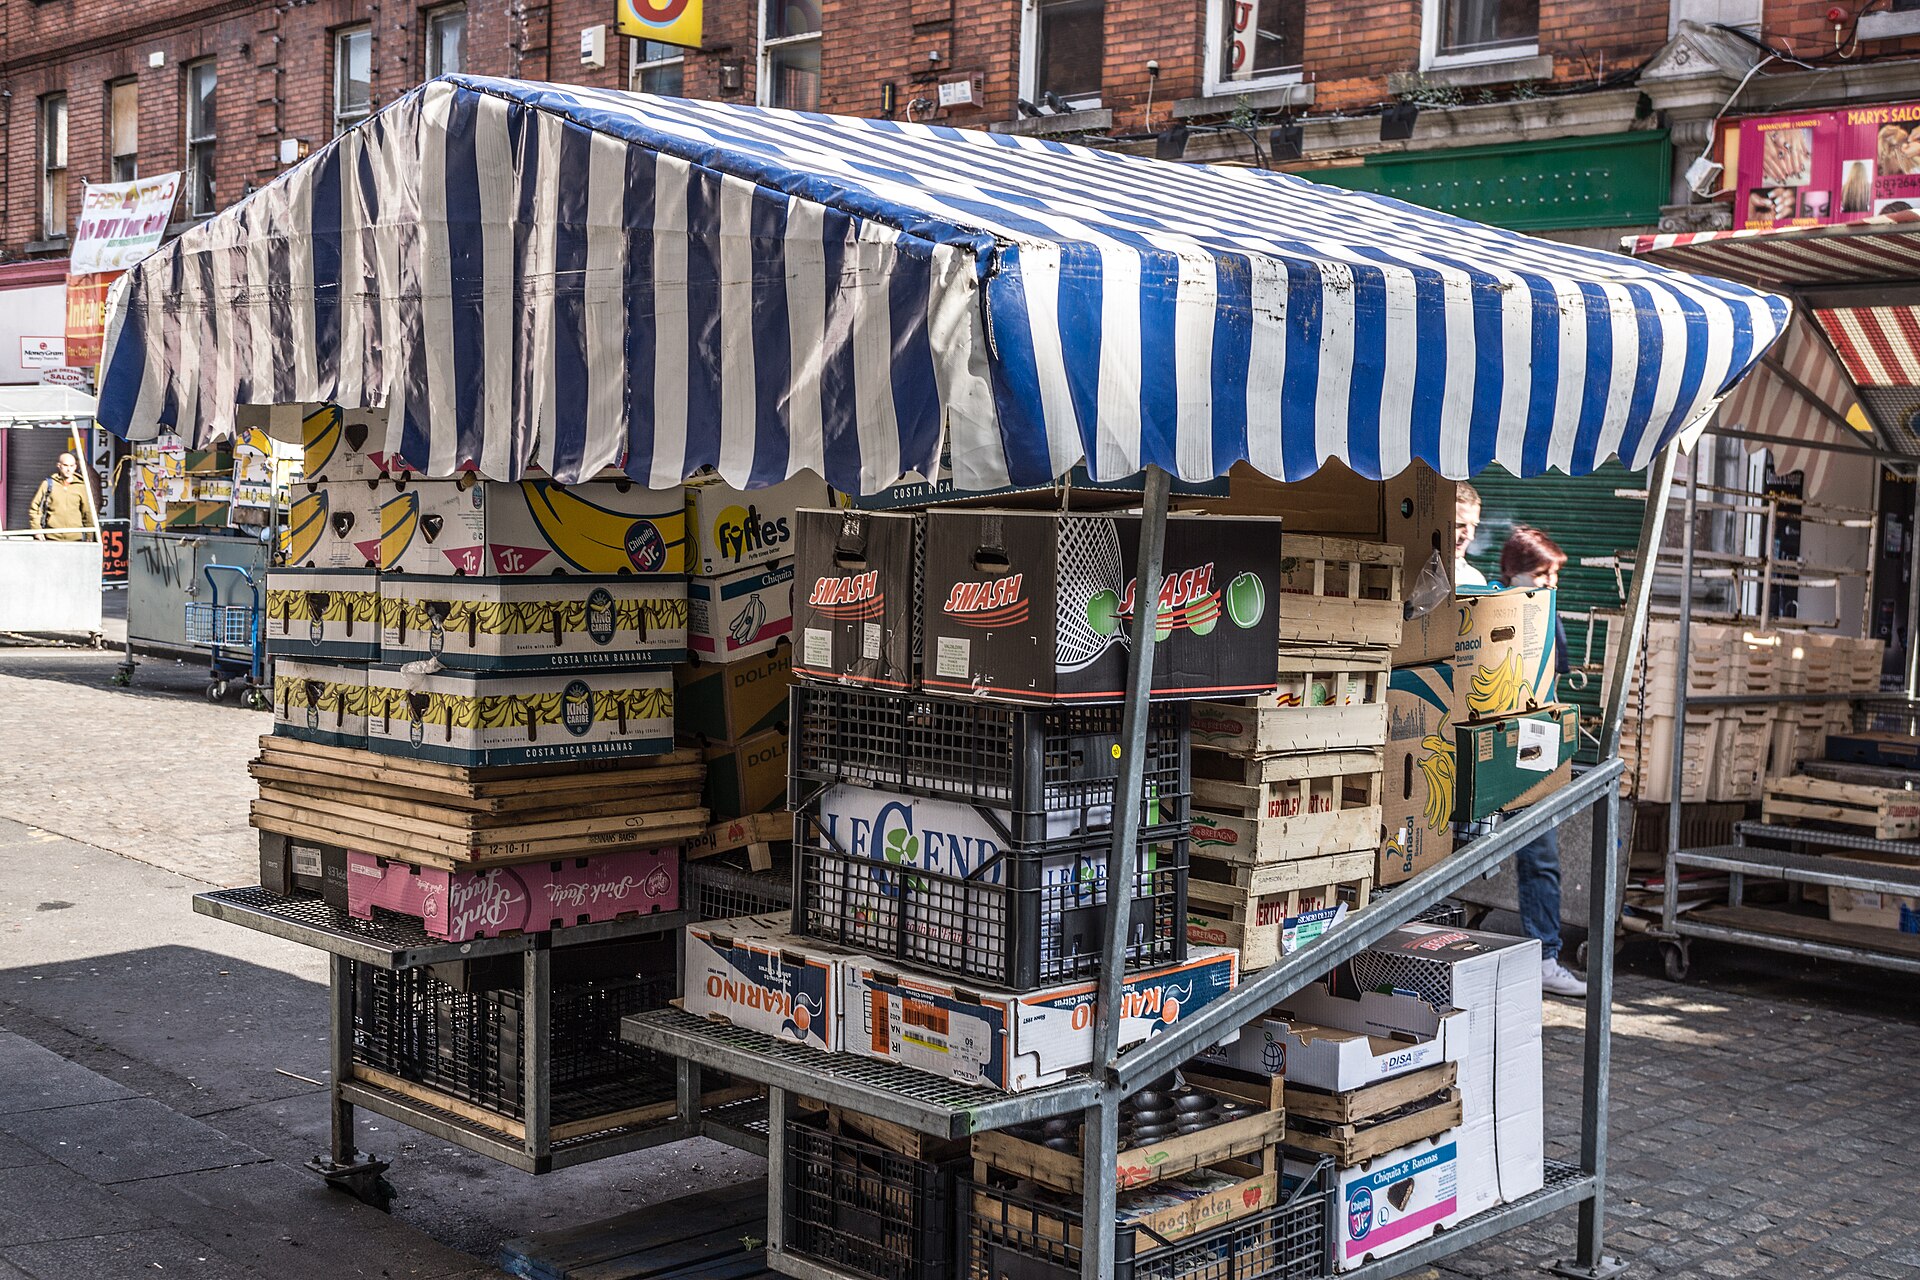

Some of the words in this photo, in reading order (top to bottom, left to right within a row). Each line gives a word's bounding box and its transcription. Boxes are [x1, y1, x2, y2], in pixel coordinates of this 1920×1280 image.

[1848, 109, 1888, 125] MARY'S
[1891, 107, 1920, 121] SALO
[88, 192, 122, 209] CASH
[122, 183, 141, 214] 4
[140, 182, 175, 205] GOLD
[95, 218, 121, 239] BUY
[50, 373, 80, 381] SALON
[893, 485, 925, 499] COSTA
[627, 528, 655, 552] Chiquita
[462, 550, 477, 571] Jr.
[499, 548, 525, 573] Jr.
[638, 545, 660, 566] Jr.
[102, 559, 111, 569] ry
[761, 571, 793, 586] Chiquita
[808, 570, 879, 605] SMASH
[943, 573, 1024, 613] SMASH
[591, 609, 611, 625] KING
[591, 623, 612, 633] CARIBE
[1455, 636, 1482, 652] anacol
[551, 655, 580, 665] COSTA
[584, 653, 610, 664] RICAN
[614, 651, 652, 662] BANANAS
[734, 656, 792, 688] DOLPHI
[566, 700, 589, 715] KING
[566, 714, 589, 724] CARIBE
[526, 748, 555, 758] COSTA
[560, 745, 588, 756] RICAN
[591, 742, 633, 754] BANANAS
[748, 740, 788, 768] DOLP
[1201, 829, 1236, 842] BRETAGNE
[489, 842, 531, 855] 12-10-11
[1402, 815, 1415, 873] Banacol
[327, 865, 347, 880] PPLES
[1046, 856, 1107, 900] LEGE
[543, 882, 590, 907] Lady
[591, 874, 642, 901] Pink
[453, 885, 525, 941] Pink
[1192, 930, 1226, 943] BRETAGNE
[706, 975, 792, 1018] KARINO
[905, 989, 920, 998] Citrus
[920, 992, 935, 1001] about
[1054, 996, 1076, 1008] Citrus
[1072, 986, 1161, 1031] KARO
[891, 1041, 901, 1053] IR
[1389, 1053, 1412, 1067] DISA
[953, 1068, 979, 1080] VALENCIA
[1373, 1165, 1402, 1185] Chiquita
[1412, 1152, 1439, 1170] Bananas
[1350, 1196, 1371, 1214] Chiquita
